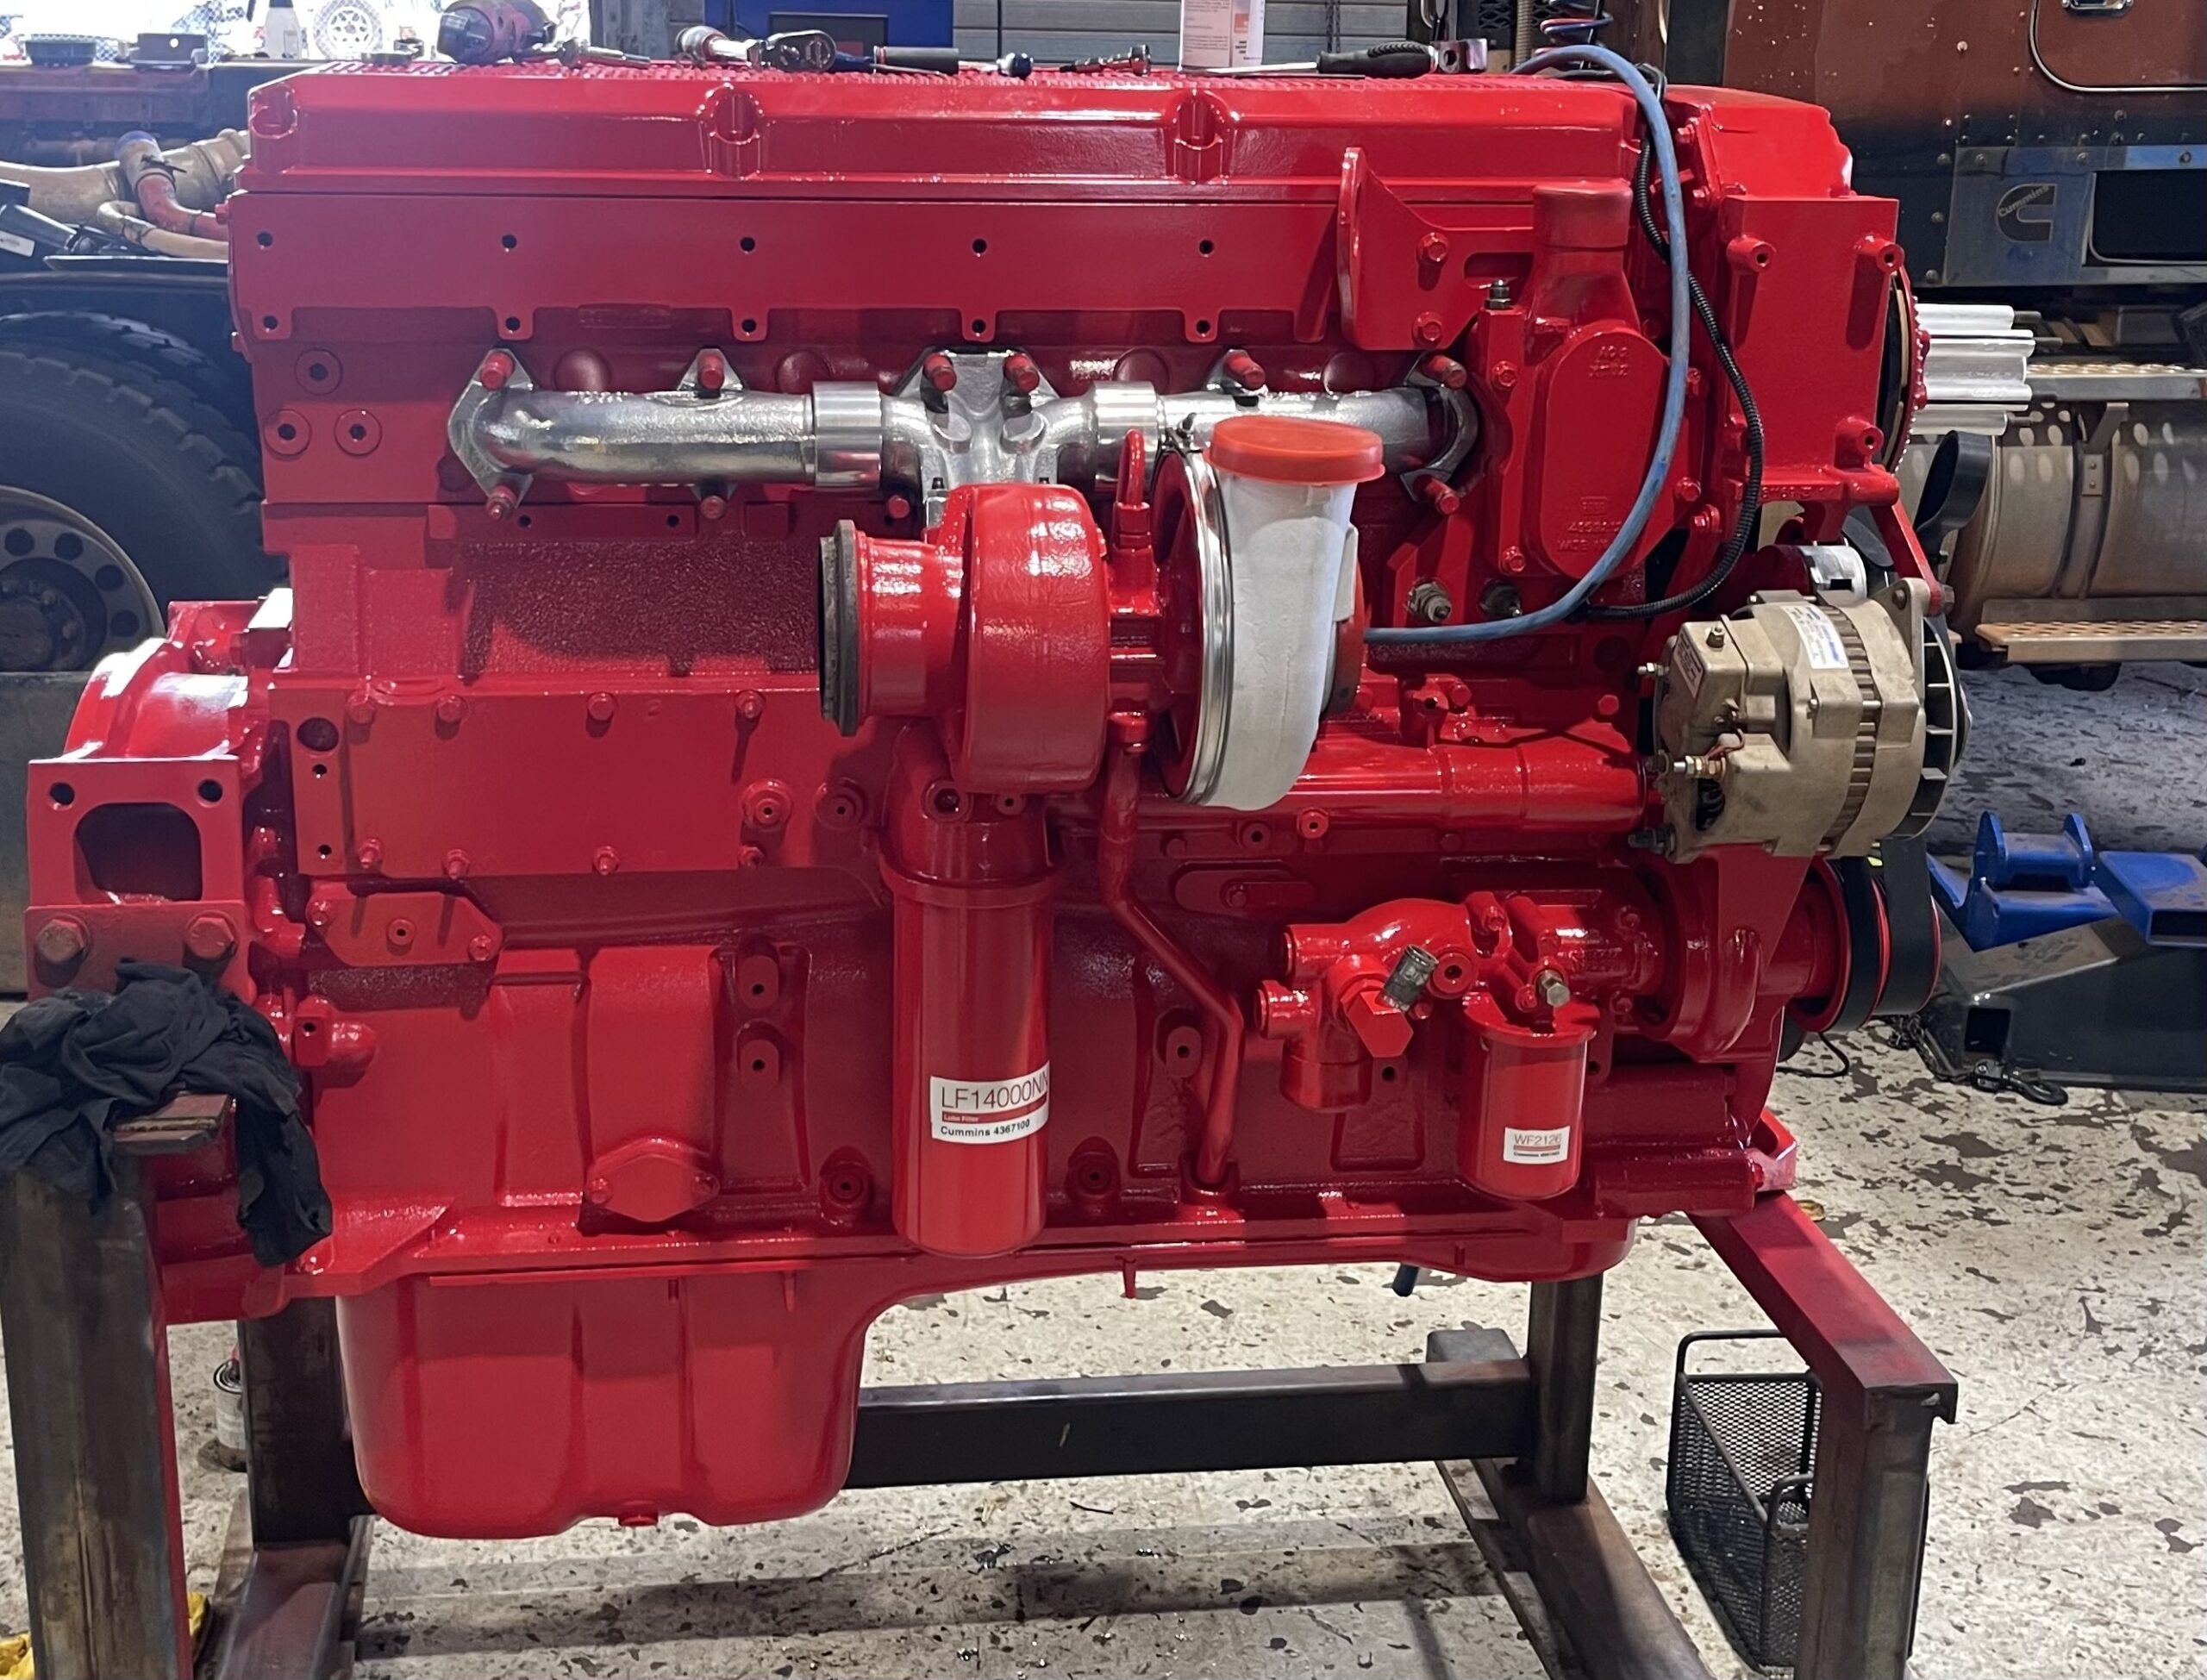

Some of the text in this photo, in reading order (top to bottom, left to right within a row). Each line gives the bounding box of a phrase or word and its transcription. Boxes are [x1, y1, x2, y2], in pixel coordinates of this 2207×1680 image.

[1999, 184, 2049, 217] Cummins
[941, 1119, 1030, 1136] Cummins 4367100
